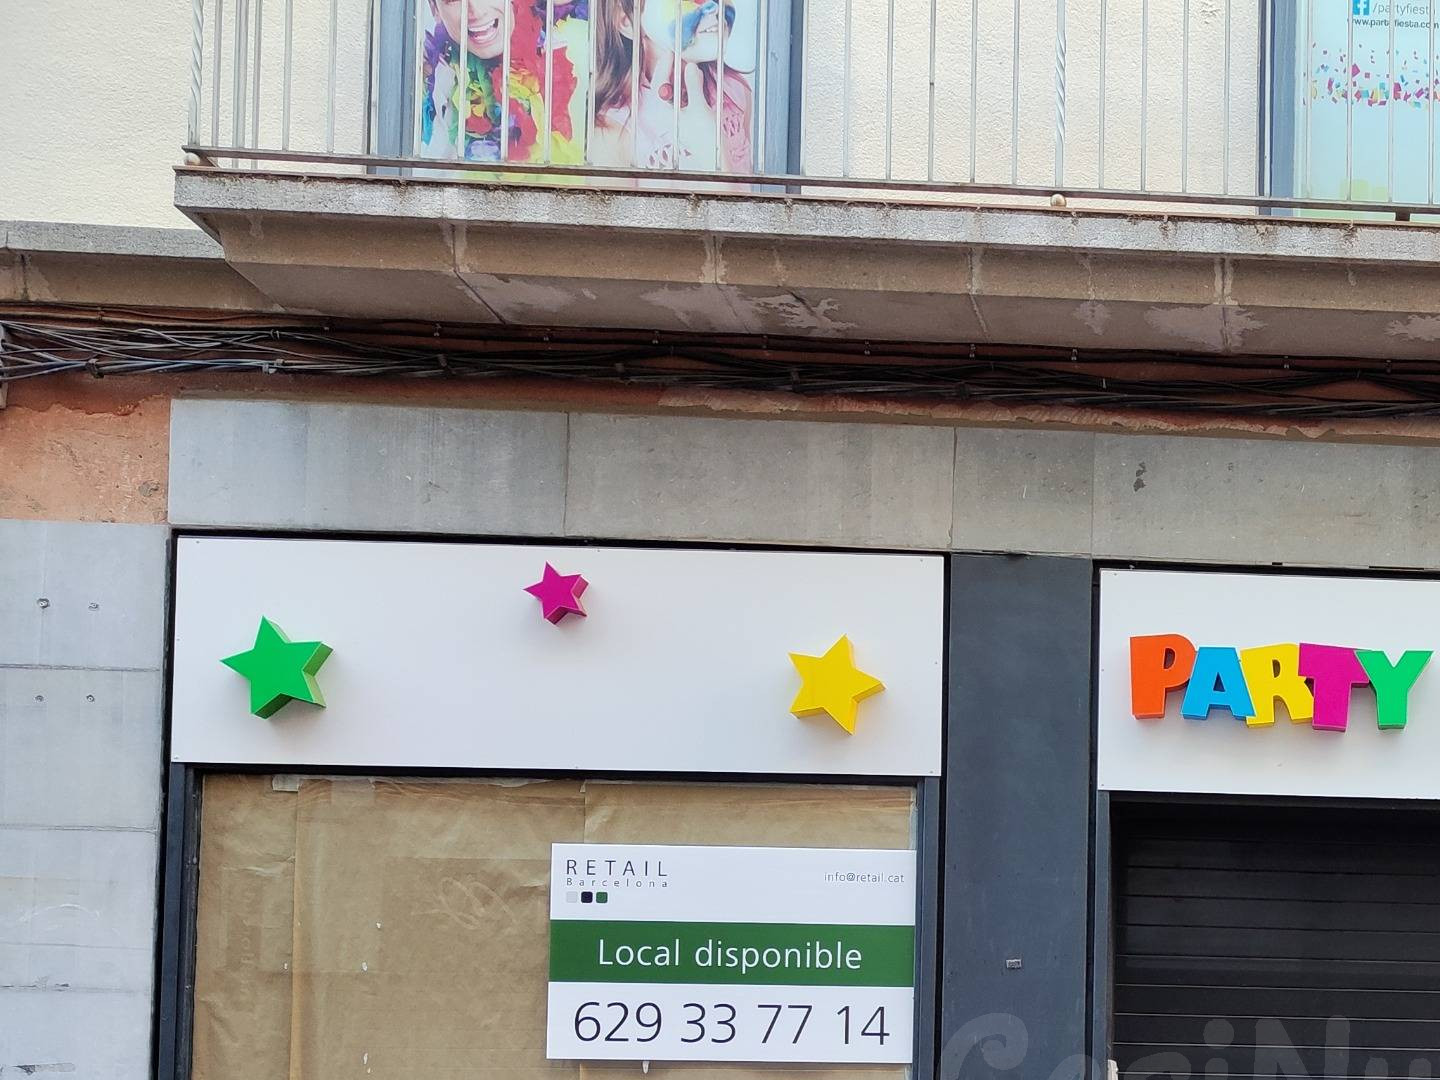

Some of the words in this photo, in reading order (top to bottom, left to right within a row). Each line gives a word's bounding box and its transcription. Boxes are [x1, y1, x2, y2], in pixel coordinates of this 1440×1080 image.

[1129, 633, 1433, 733] PARTY
[566, 859, 668, 877] RETAIL
[823, 871, 905, 883] info@retail.cat
[566, 877, 668, 888] Barcelona
[599, 938, 680, 966] Local
[695, 940, 863, 974] disponible
[574, 1001, 663, 1042] 629
[680, 1003, 737, 1044] 33
[757, 1004, 813, 1044] 77
[836, 1005, 890, 1046] 14
